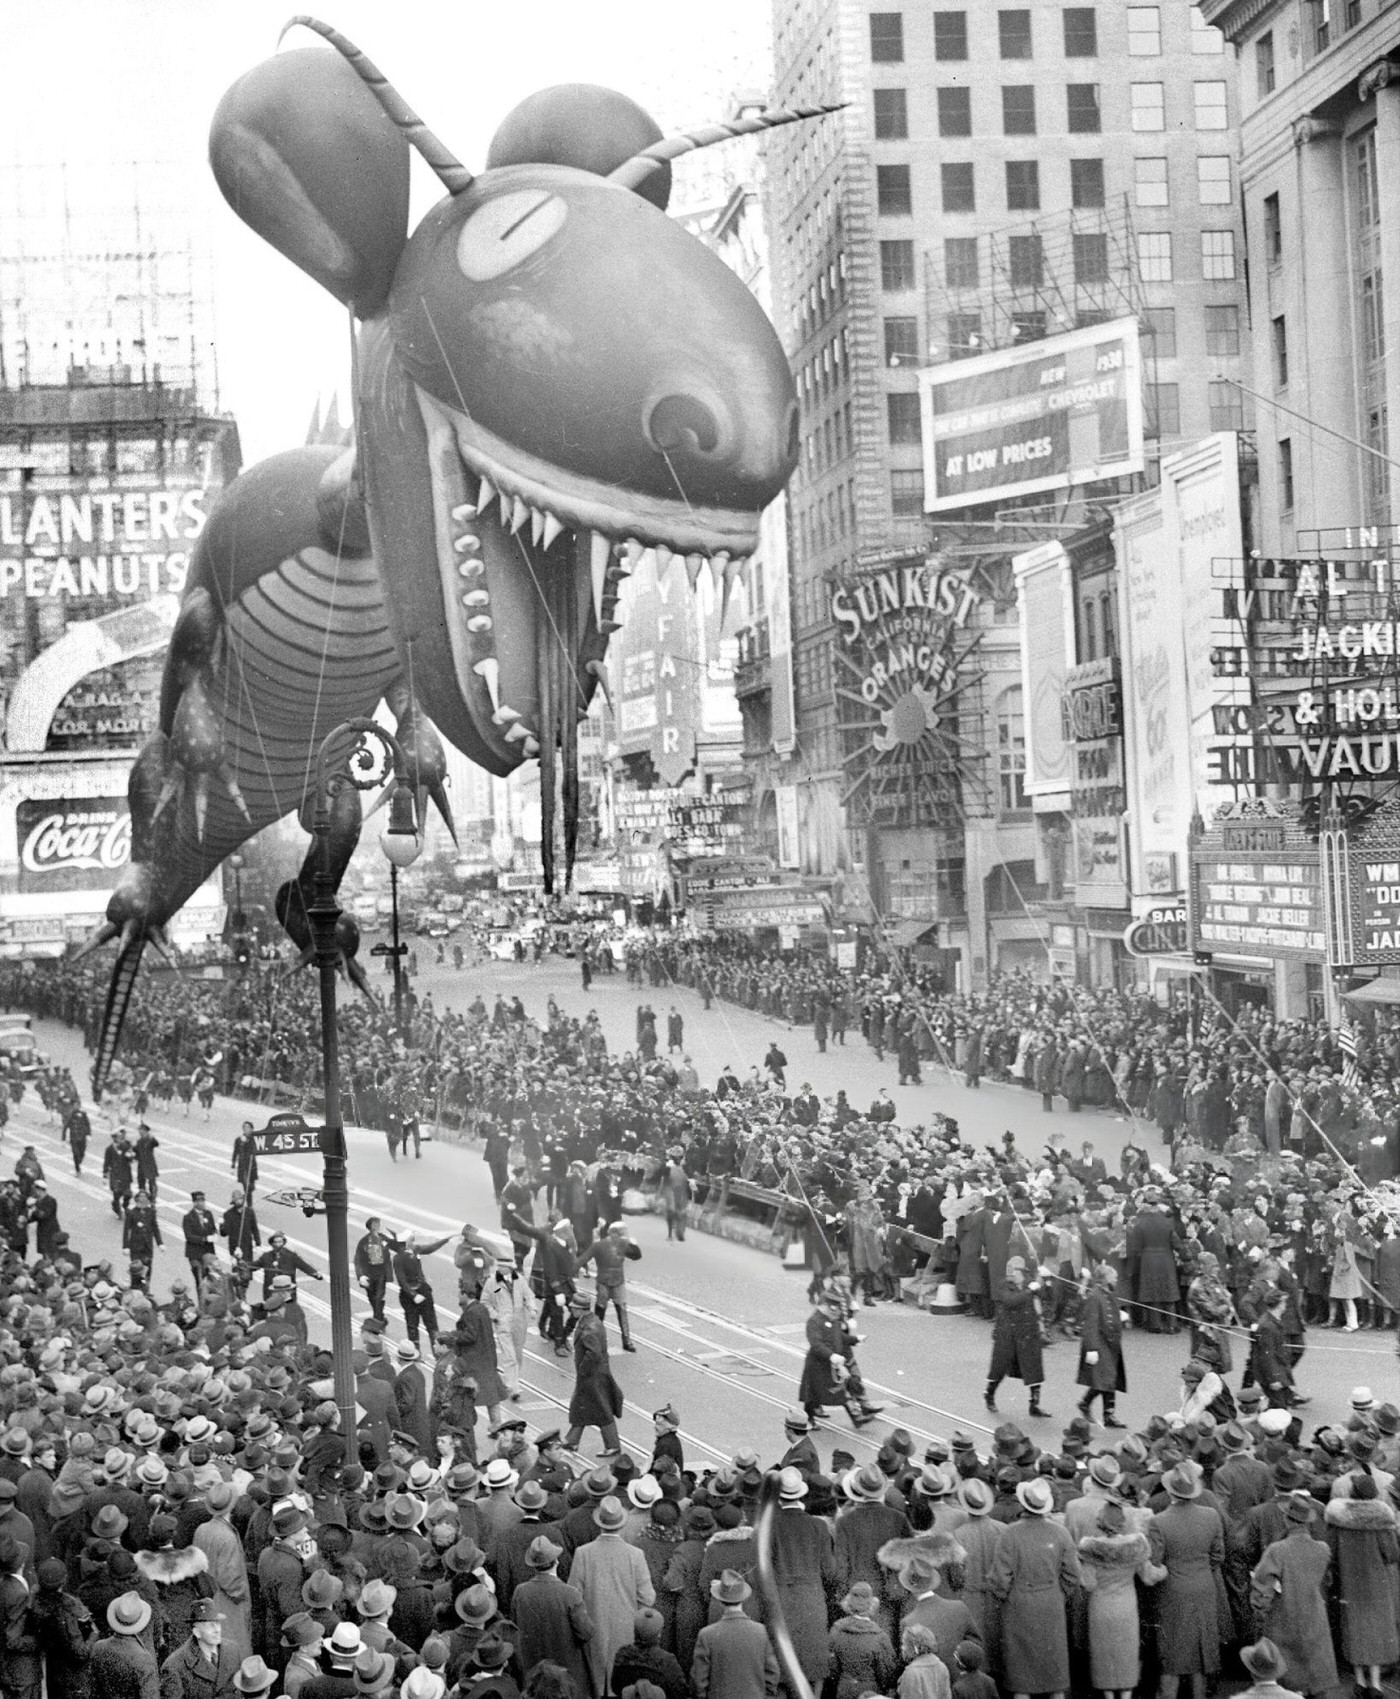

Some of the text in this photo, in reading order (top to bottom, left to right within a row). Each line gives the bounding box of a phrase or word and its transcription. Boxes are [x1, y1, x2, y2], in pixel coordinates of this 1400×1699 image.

[1040, 366, 1066, 385] NEW
[1048, 378, 1116, 409] CHEVROLET
[946, 436, 1052, 477] AT LOW PRICES
[0, 490, 207, 544] LANTERS
[1346, 526, 1378, 548] IN
[0, 552, 188, 598] PEANUTS
[1296, 563, 1348, 597] AL
[832, 566, 980, 646] SUNKIST
[866, 616, 946, 650] CALIFORNIA
[655, 578, 680, 754] YFAIR
[861, 643, 956, 702] ORANGES
[1295, 691, 1319, 724] &
[1335, 687, 1400, 722] HOL
[1300, 735, 1400, 777] VAU
[66, 811, 118, 826] DRINK
[22, 812, 132, 872] Coca-C
[1366, 863, 1399, 882] WM
[1151, 908, 1187, 924] BAR
[253, 1134, 269, 1151] W.
[272, 1133, 295, 1151] 45
